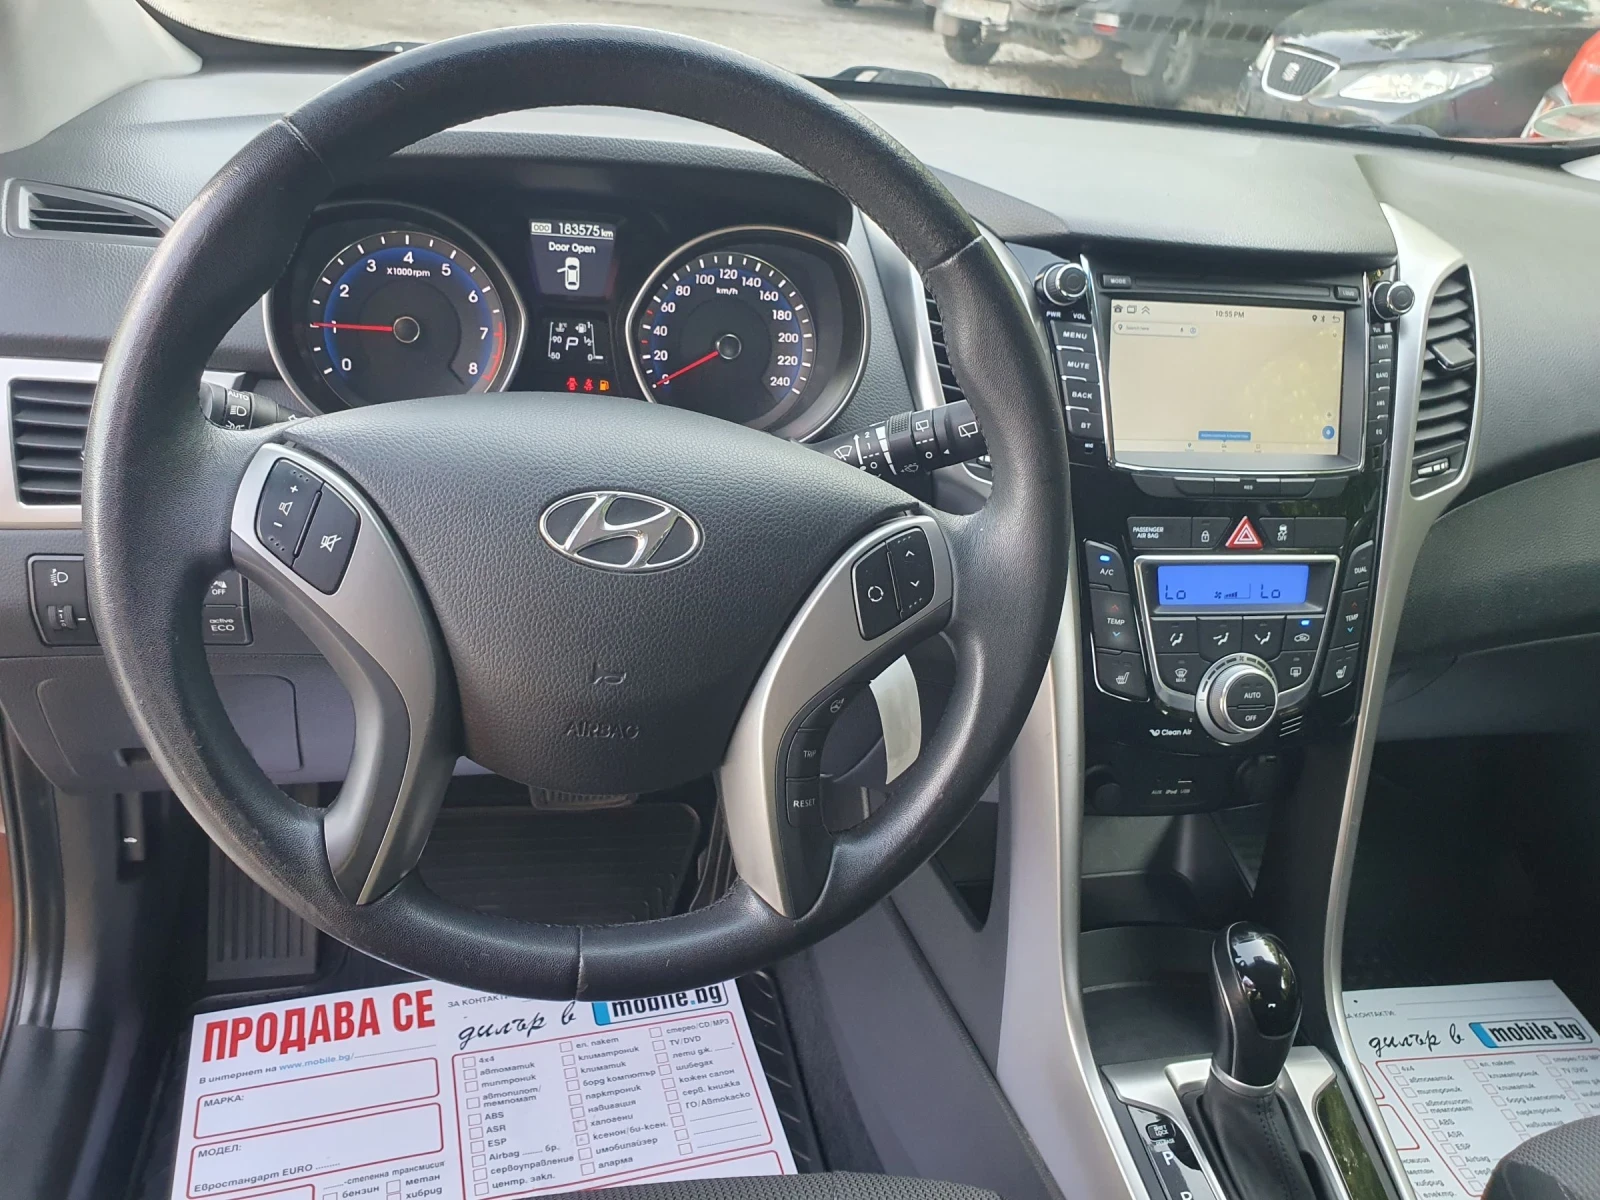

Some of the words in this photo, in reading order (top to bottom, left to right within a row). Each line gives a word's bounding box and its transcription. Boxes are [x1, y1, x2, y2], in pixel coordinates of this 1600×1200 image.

[558, 222, 600, 237] 183575
[600, 228, 614, 238] km
[548, 241, 570, 252] Door
[571, 243, 596, 254] Open
[403, 251, 414, 264] 4
[366, 259, 377, 272] 3
[441, 263, 451, 277] 5
[695, 274, 715, 285] 100
[719, 268, 738, 280] 120
[741, 276, 761, 288] 140
[339, 284, 349, 298] 2
[468, 290, 479, 303] 6
[675, 285, 691, 296] 80
[716, 286, 739, 296] km/h
[759, 290, 779, 302] 160
[660, 302, 676, 313] 60
[1215, 310, 1233, 318] 10:55
[772, 309, 792, 321] 180
[479, 327, 489, 340] 7
[653, 325, 668, 337] 40
[777, 332, 799, 343] 200
[1062, 330, 1088, 340] MENU
[653, 350, 668, 361] 20
[777, 355, 798, 366] 220
[341, 358, 352, 371] 0
[468, 362, 478, 375] 8
[1066, 361, 1090, 370] MUTE
[770, 376, 790, 387] 240
[228, 391, 250, 401] AUTO
[1071, 391, 1093, 400] BACK
[864, 431, 870, 439] 2
[1100, 568, 1114, 577] A/C
[1354, 566, 1367, 575] DUAL
[211, 588, 226, 596] OFF
[1165, 584, 1186, 600] Lo
[1260, 583, 1281, 599] Lo
[1107, 617, 1125, 626] TEMP
[1345, 614, 1359, 622] TEMP
[210, 624, 235, 632] ECO
[1245, 714, 1257, 722] OFF
[803, 750, 817, 758] TRIP
[793, 798, 815, 808] RESET
[202, 997, 381, 1063] ПРОДАВА
[392, 989, 436, 1033] СЕ
[458, 1012, 548, 1051] дилър
[591, 1037, 619, 1046] пакет
[669, 1035, 702, 1046] TV/DVD
[1368, 1030, 1441, 1058] дилър
[1487, 1020, 1586, 1043] mobile.bg
[578, 1046, 640, 1061] климатроник
[672, 1049, 696, 1059] лети
[479, 1062, 536, 1076] автоматик
[580, 1061, 627, 1074] климатик
[675, 1059, 714, 1071] шибедах
[199, 1077, 206, 1085] В
[208, 1068, 263, 1083] интернет
[265, 1065, 277, 1073] на
[481, 1074, 537, 1088] типтроник
[582, 1078, 606, 1086] борд
[606, 1069, 656, 1083] компютър
[679, 1073, 708, 1084] кожен
[708, 1068, 735, 1078] салон
[585, 1084, 642, 1100] парктроник
[682, 1086, 706, 1097] серв.
[707, 1079, 741, 1091] книжка
[203, 1093, 245, 1108] МАРКА:
[483, 1094, 537, 1108] темпомат
[587, 1099, 637, 1113] навигация
[685, 1091, 751, 1109] ГО/Автокаско
[484, 1111, 505, 1121] ABS
[590, 1113, 634, 1127] халогени
[486, 1124, 507, 1134] ASR
[487, 1138, 507, 1148] ESP
[595, 1137, 659, 1155] имобилайзер
[197, 1144, 242, 1158] МОДЕЛ:
[488, 1150, 520, 1161] Airbag
[544, 1144, 561, 1153] бр.
[490, 1155, 575, 1175] сервоуправление
[598, 1156, 634, 1169] аларма
[1162, 1151, 1174, 1166] P
[392, 1160, 445, 1177] трансмисия
[193, 1172, 280, 1193] Евростандарт
[282, 1163, 314, 1177] EURO
[405, 1173, 441, 1186] метан
[492, 1178, 528, 1190] центр.
[530, 1173, 556, 1183] закл.
[342, 1185, 380, 1199] бензин
[405, 1186, 443, 1200] хибрид
